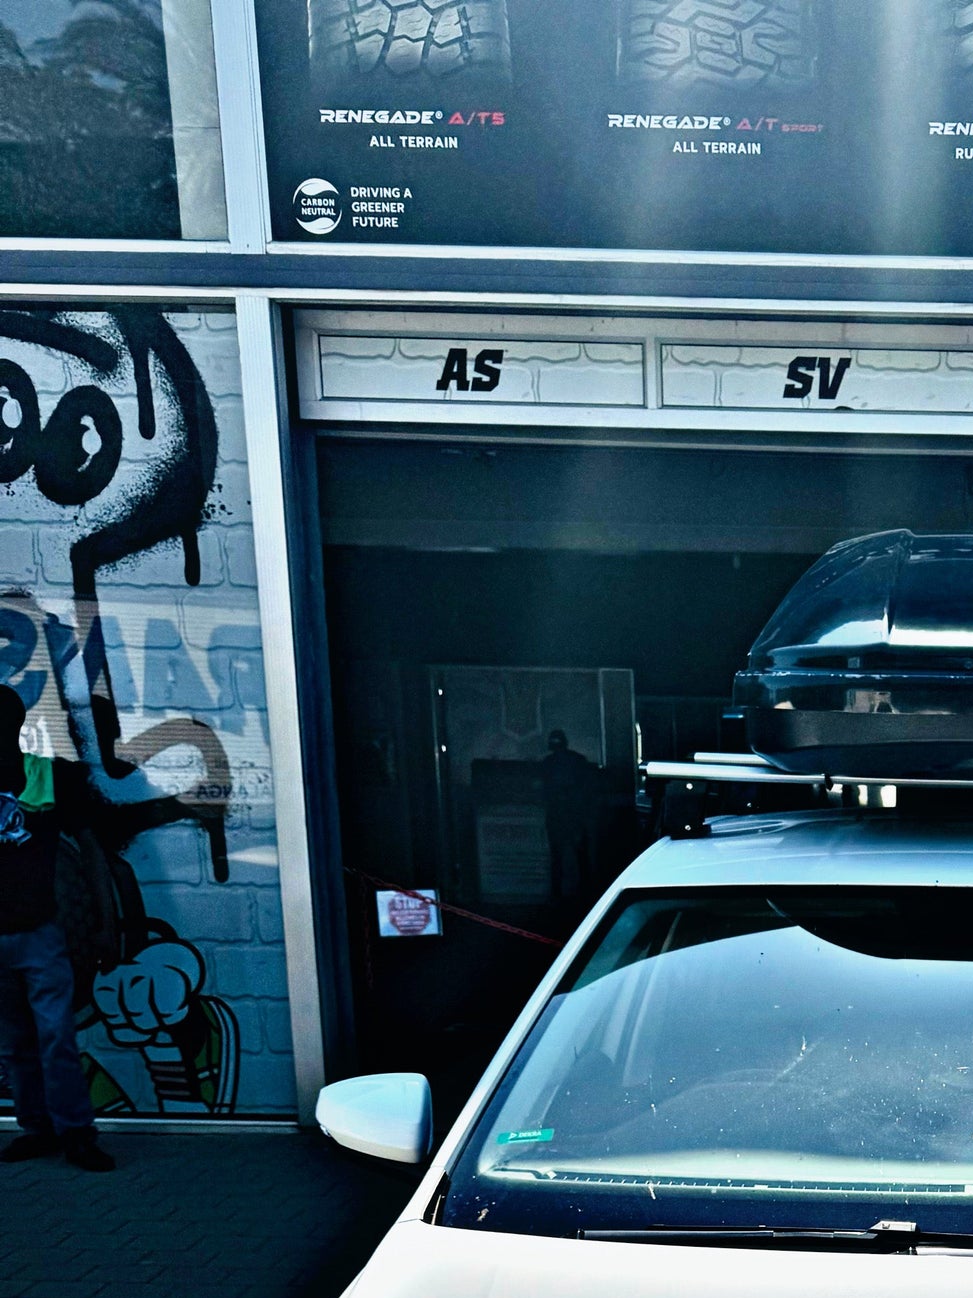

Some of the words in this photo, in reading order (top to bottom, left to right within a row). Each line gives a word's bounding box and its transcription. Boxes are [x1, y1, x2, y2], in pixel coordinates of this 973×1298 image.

[736, 117, 779, 131] A/T
[369, 136, 395, 148] ALL
[400, 136, 458, 149] TERRAIN
[673, 141, 698, 153] ALL
[703, 141, 762, 155] TERRAIN
[350, 187, 401, 199] DRIVING
[403, 188, 413, 199] A
[301, 198, 335, 207] CARBON
[351, 202, 405, 213] GREENER
[301, 207, 336, 216] NEUTRAL
[352, 216, 399, 228] FUTURE
[435, 348, 504, 392] AS
[783, 356, 851, 400] SV
